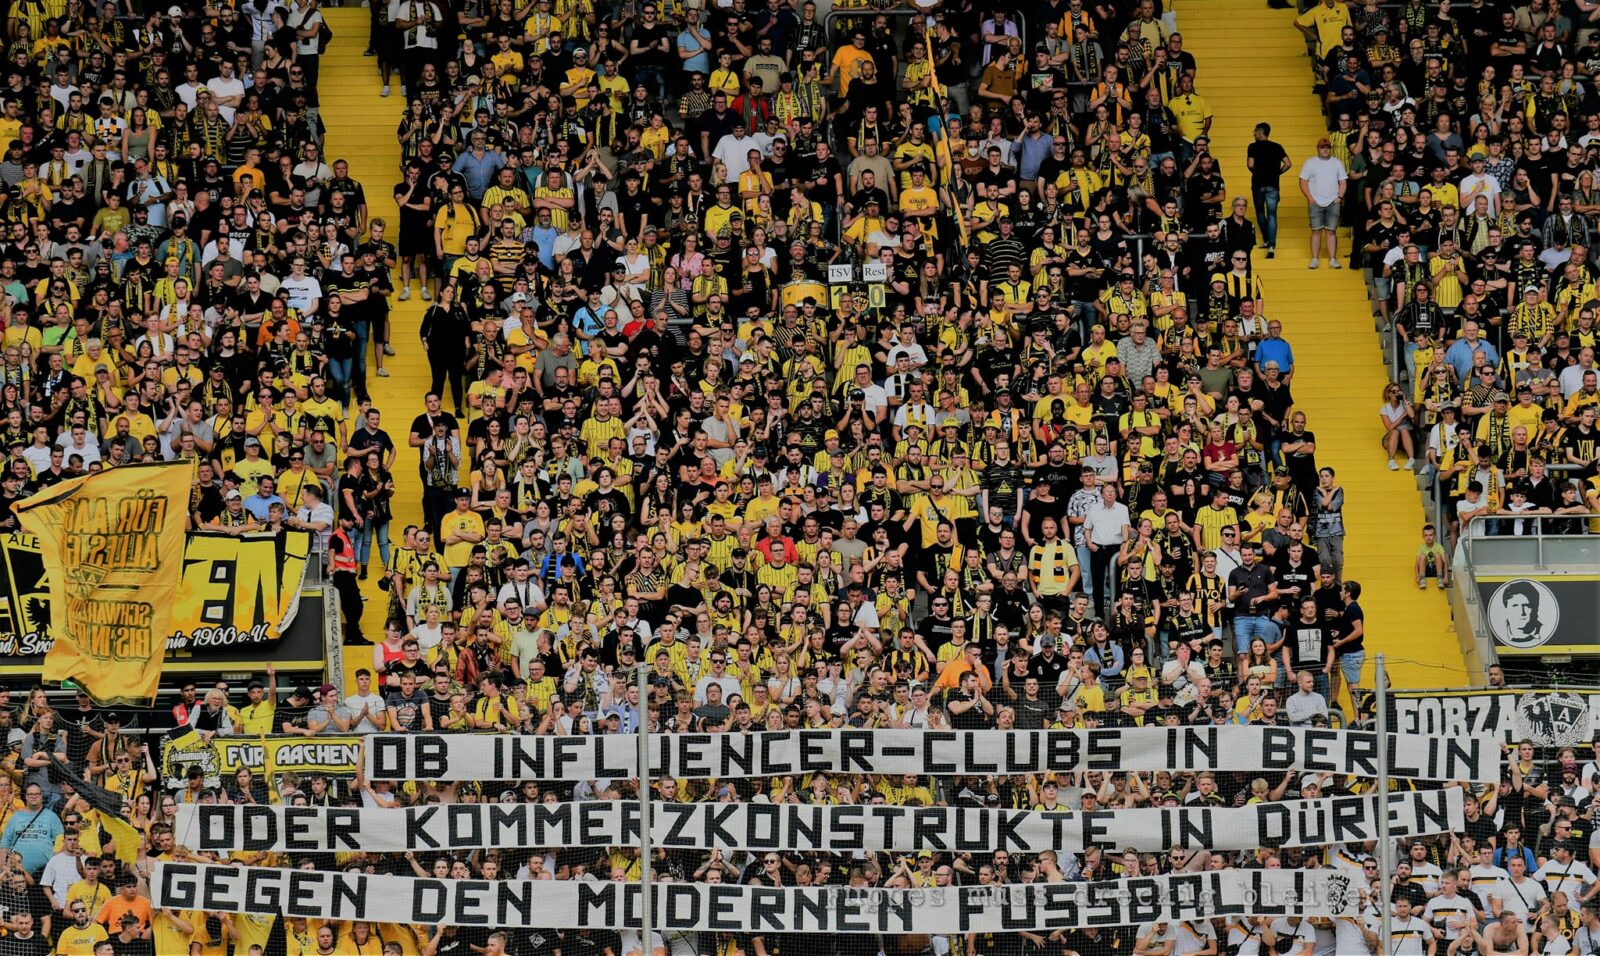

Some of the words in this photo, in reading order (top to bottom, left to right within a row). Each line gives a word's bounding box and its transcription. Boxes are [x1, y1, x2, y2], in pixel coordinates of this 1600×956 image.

[830, 267, 850, 278] TSV
[865, 267, 886, 277] Rest
[1395, 694, 1518, 743] FORZA
[226, 744, 265, 767] FÜR
[276, 744, 359, 767] AACHEN
[373, 736, 448, 779] OB
[494, 729, 1122, 779] INFLUENCER-CLUBS
[1167, 728, 1218, 769] IN
[1262, 727, 1480, 780] BERLIN
[199, 805, 361, 851] ODER
[405, 802, 1117, 850] KOMMERZKONSTRUKTE
[1161, 808, 1213, 850] IN
[1257, 790, 1451, 847] DÜREN
[161, 863, 367, 919] GEGEN
[412, 880, 532, 925] DEN
[577, 882, 913, 932] MODERNEN
[958, 870, 1304, 931] FUSSBALL!
